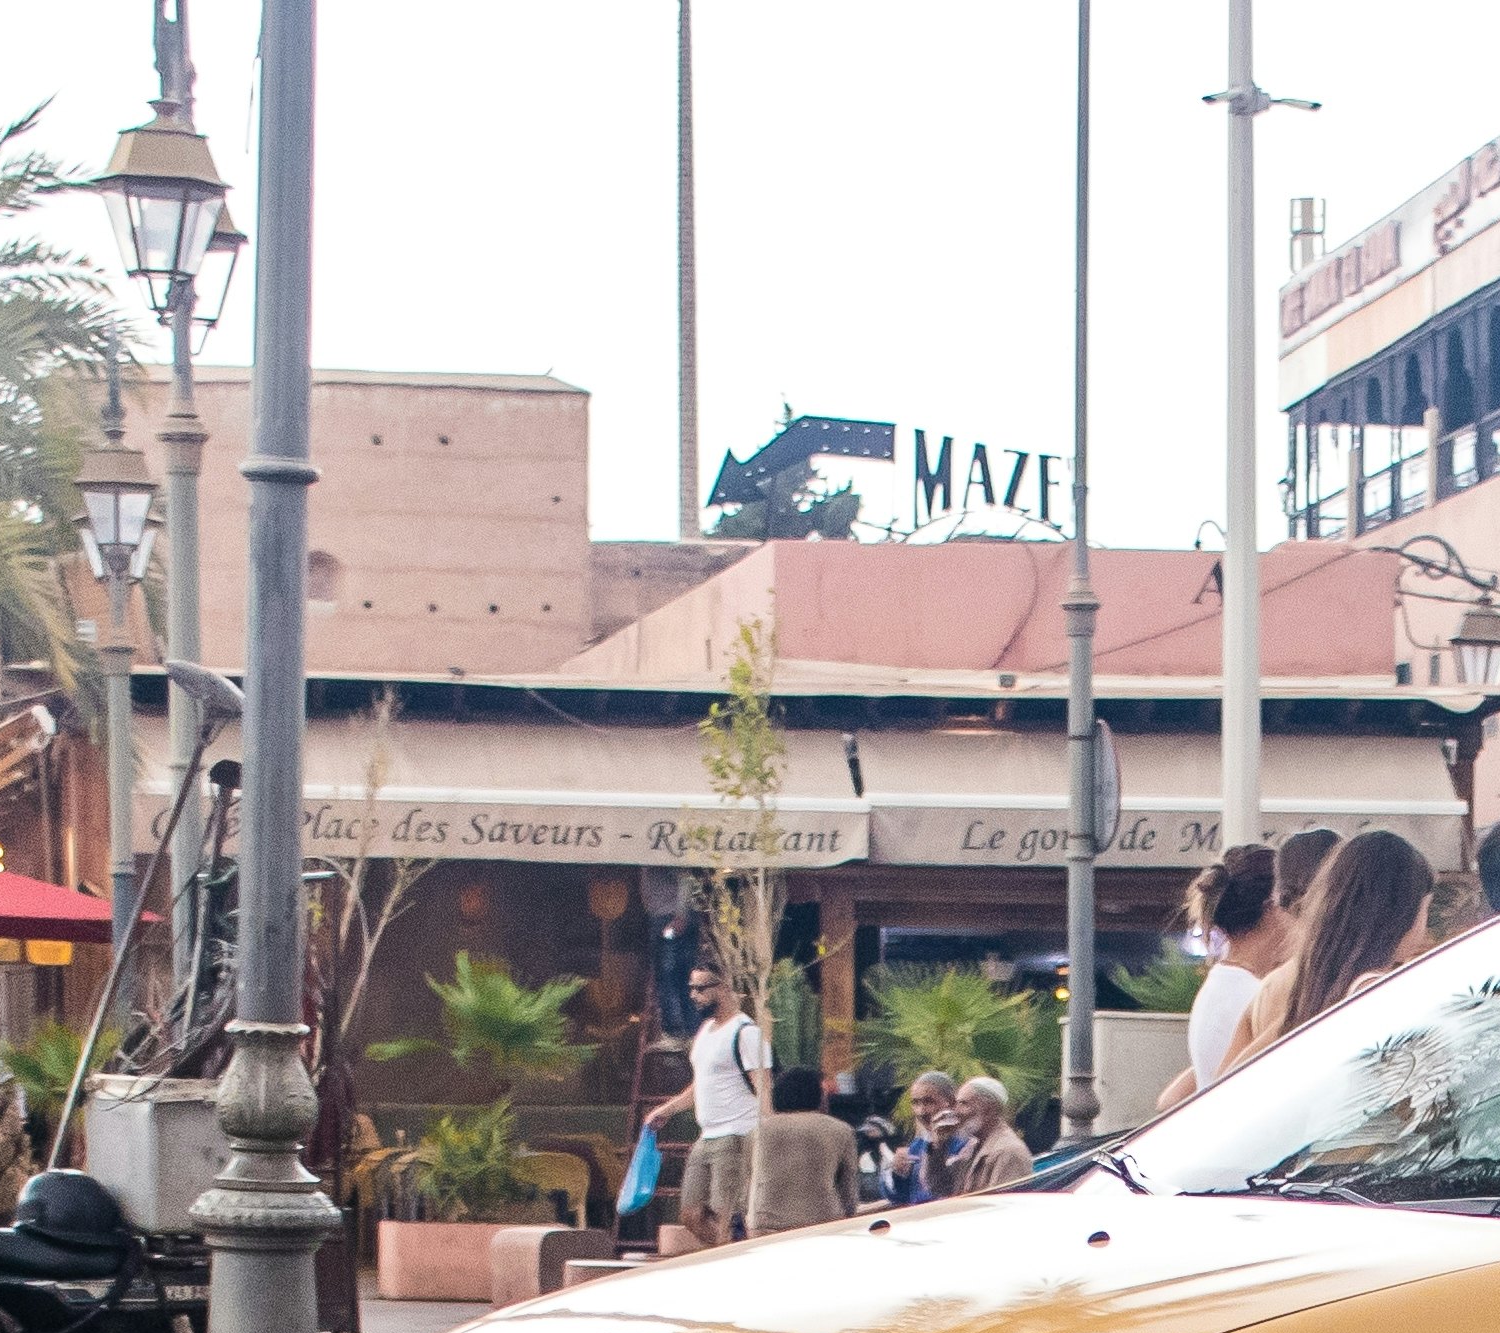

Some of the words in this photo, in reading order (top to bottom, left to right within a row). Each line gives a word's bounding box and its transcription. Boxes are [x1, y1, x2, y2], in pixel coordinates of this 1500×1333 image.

[914, 428, 1072, 532] MAZE
[392, 808, 450, 844] des
[462, 813, 603, 848] Saveurs
[961, 820, 1005, 850] Le
[1119, 816, 1156, 850] de
